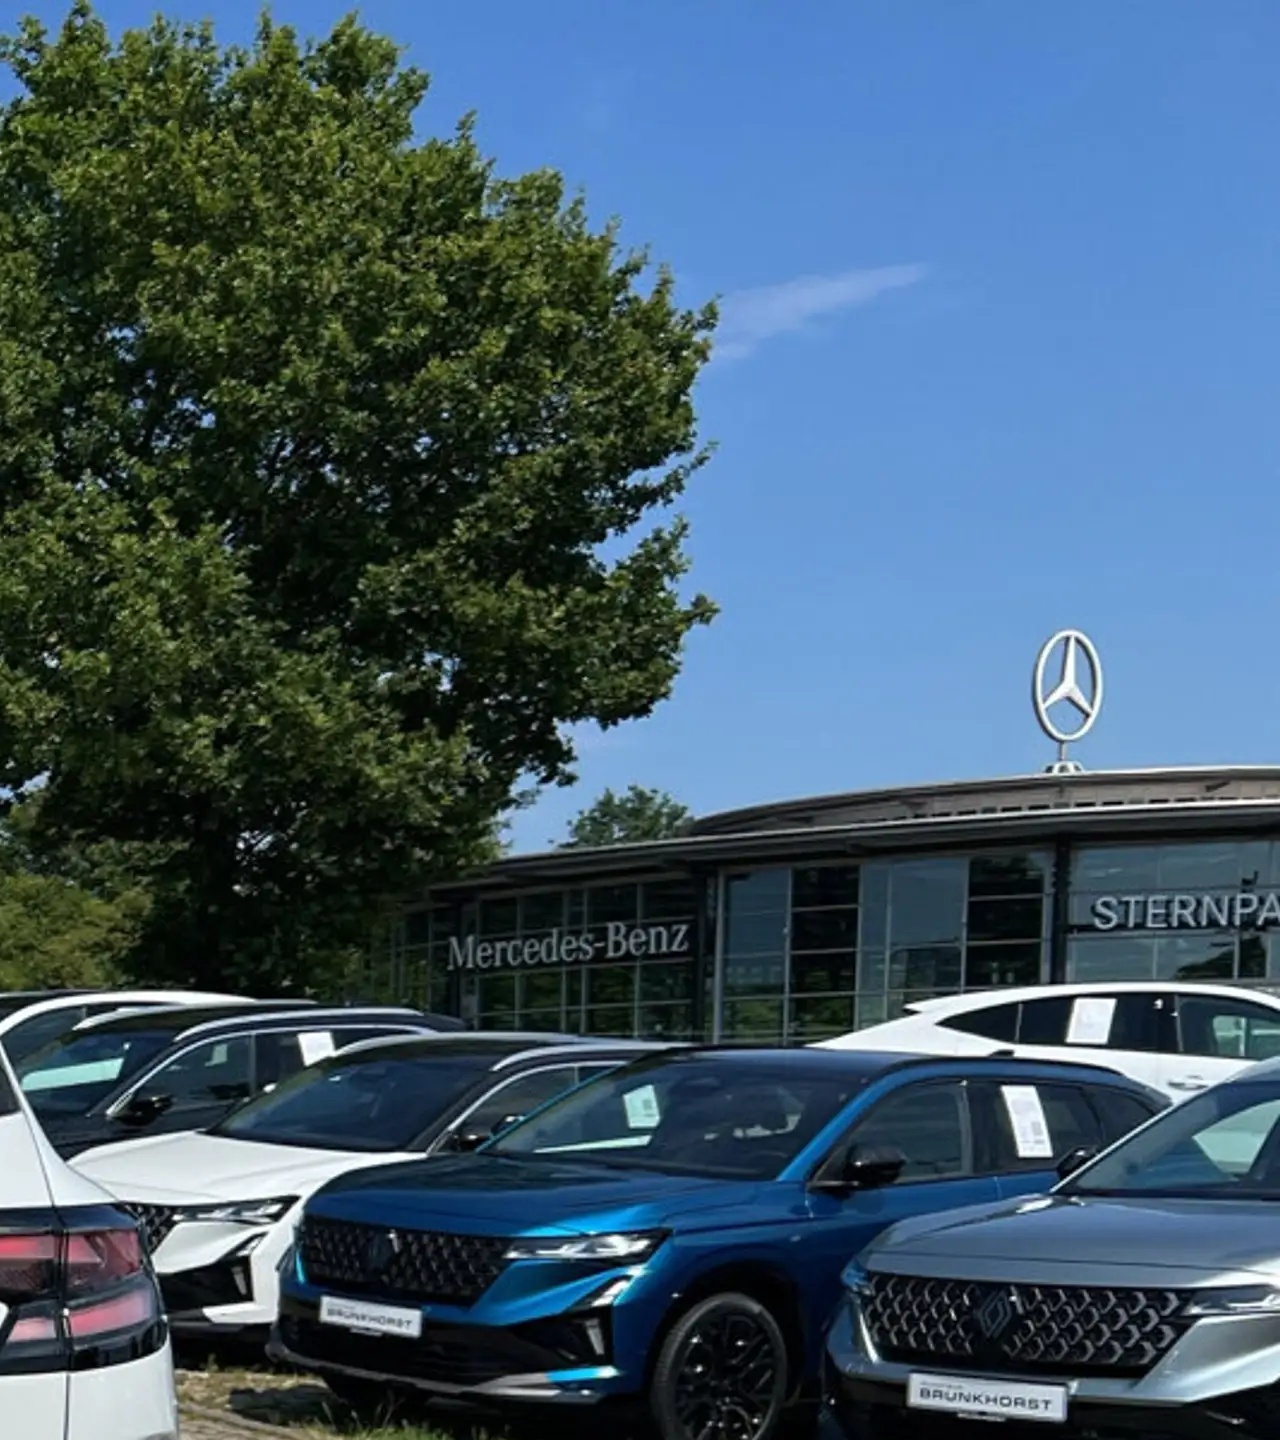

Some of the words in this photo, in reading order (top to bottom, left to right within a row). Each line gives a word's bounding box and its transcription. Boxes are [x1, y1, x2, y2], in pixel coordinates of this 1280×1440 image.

[1093, 892, 1280, 930] STERNPA
[446, 921, 690, 971] Mercedes-Benz
[919, 1387, 1053, 1411] BRUNKHORST
